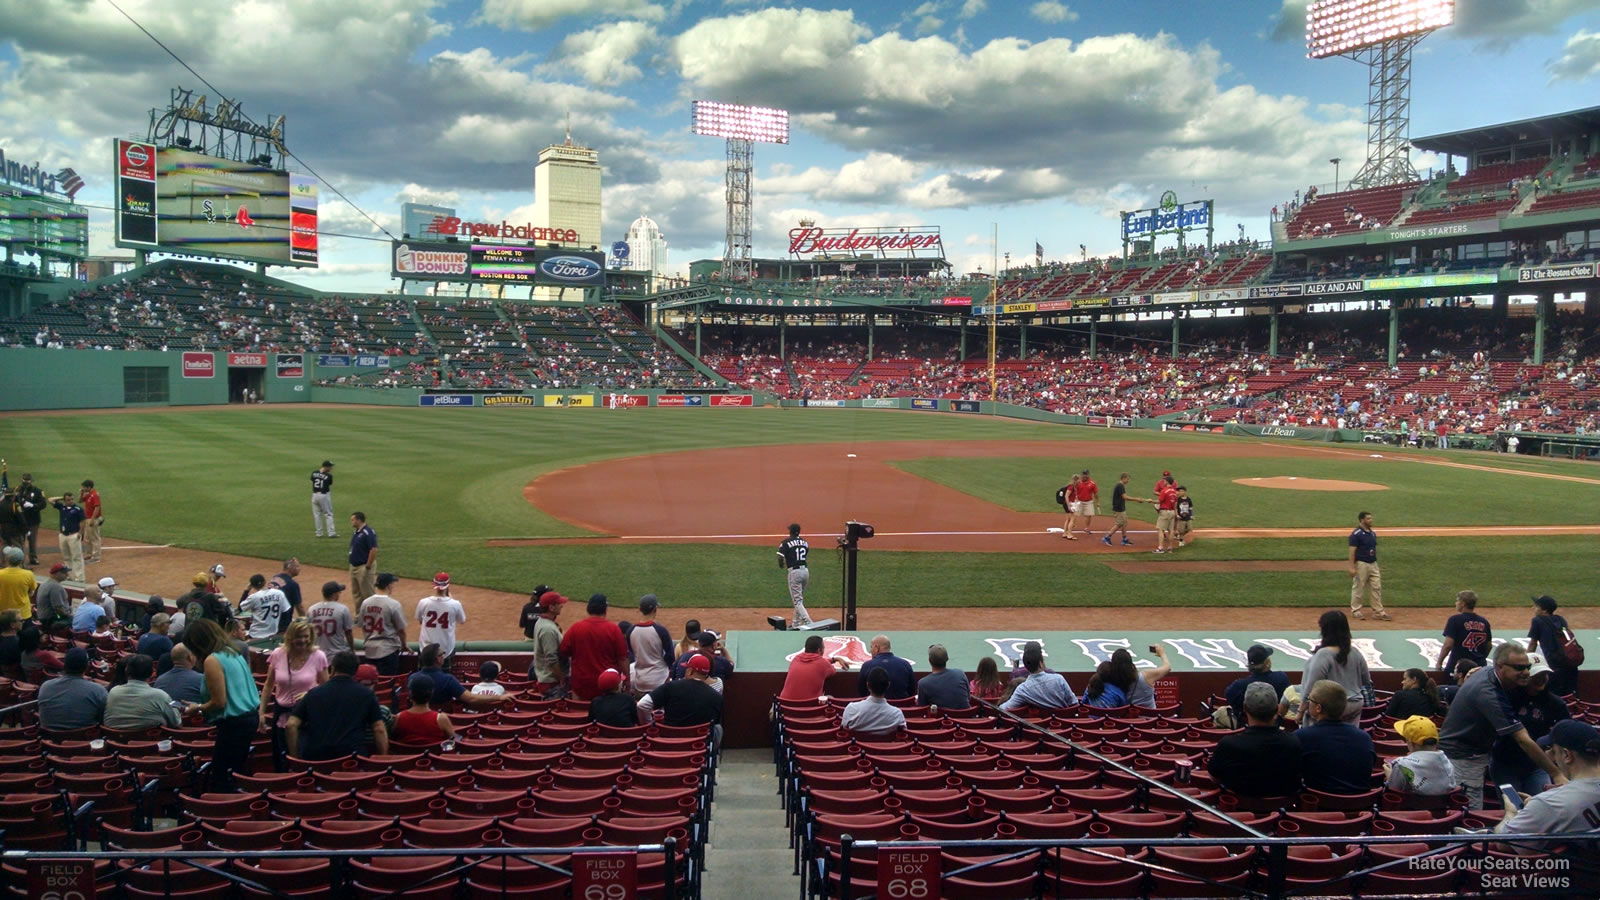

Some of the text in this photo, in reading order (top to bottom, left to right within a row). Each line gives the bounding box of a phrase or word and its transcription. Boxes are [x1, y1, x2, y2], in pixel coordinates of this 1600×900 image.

[154, 86, 212, 139] John
[127, 152, 147, 160] NISSAN
[1125, 200, 1209, 233] Cumberland
[461, 220, 577, 242] new balance
[1390, 225, 1468, 239] TONIGHT'S STARTERS
[789, 227, 940, 254] Budweiser
[416, 252, 466, 263] DUNKIN'
[416, 262, 465, 273] DONUTS
[553, 258, 589, 276] Ford
[1534, 266, 1591, 279] The Boston Globe
[1307, 281, 1362, 294] ALEX AND ANI
[234, 355, 262, 364] aetna
[434, 395, 460, 406] jetBlue
[485, 396, 532, 405] GRANITE CITY
[1261, 426, 1296, 436] L.L.Bean
[314, 479, 324, 488] 21
[795, 547, 807, 560] 12
[261, 603, 280, 621] 79
[312, 607, 334, 617] BETTS
[364, 615, 385, 634] 34
[425, 611, 449, 628] 24
[312, 619, 337, 637] 50
[1462, 631, 1487, 652] 47
[586, 859, 625, 869] FIELD
[889, 853, 929, 864] FIELD
[41, 865, 84, 875] FIELD
[591, 870, 620, 880] BOX
[893, 864, 924, 874] BOX
[47, 876, 78, 886] BOX
[584, 884, 627, 900] 69
[887, 879, 929, 898] 68
